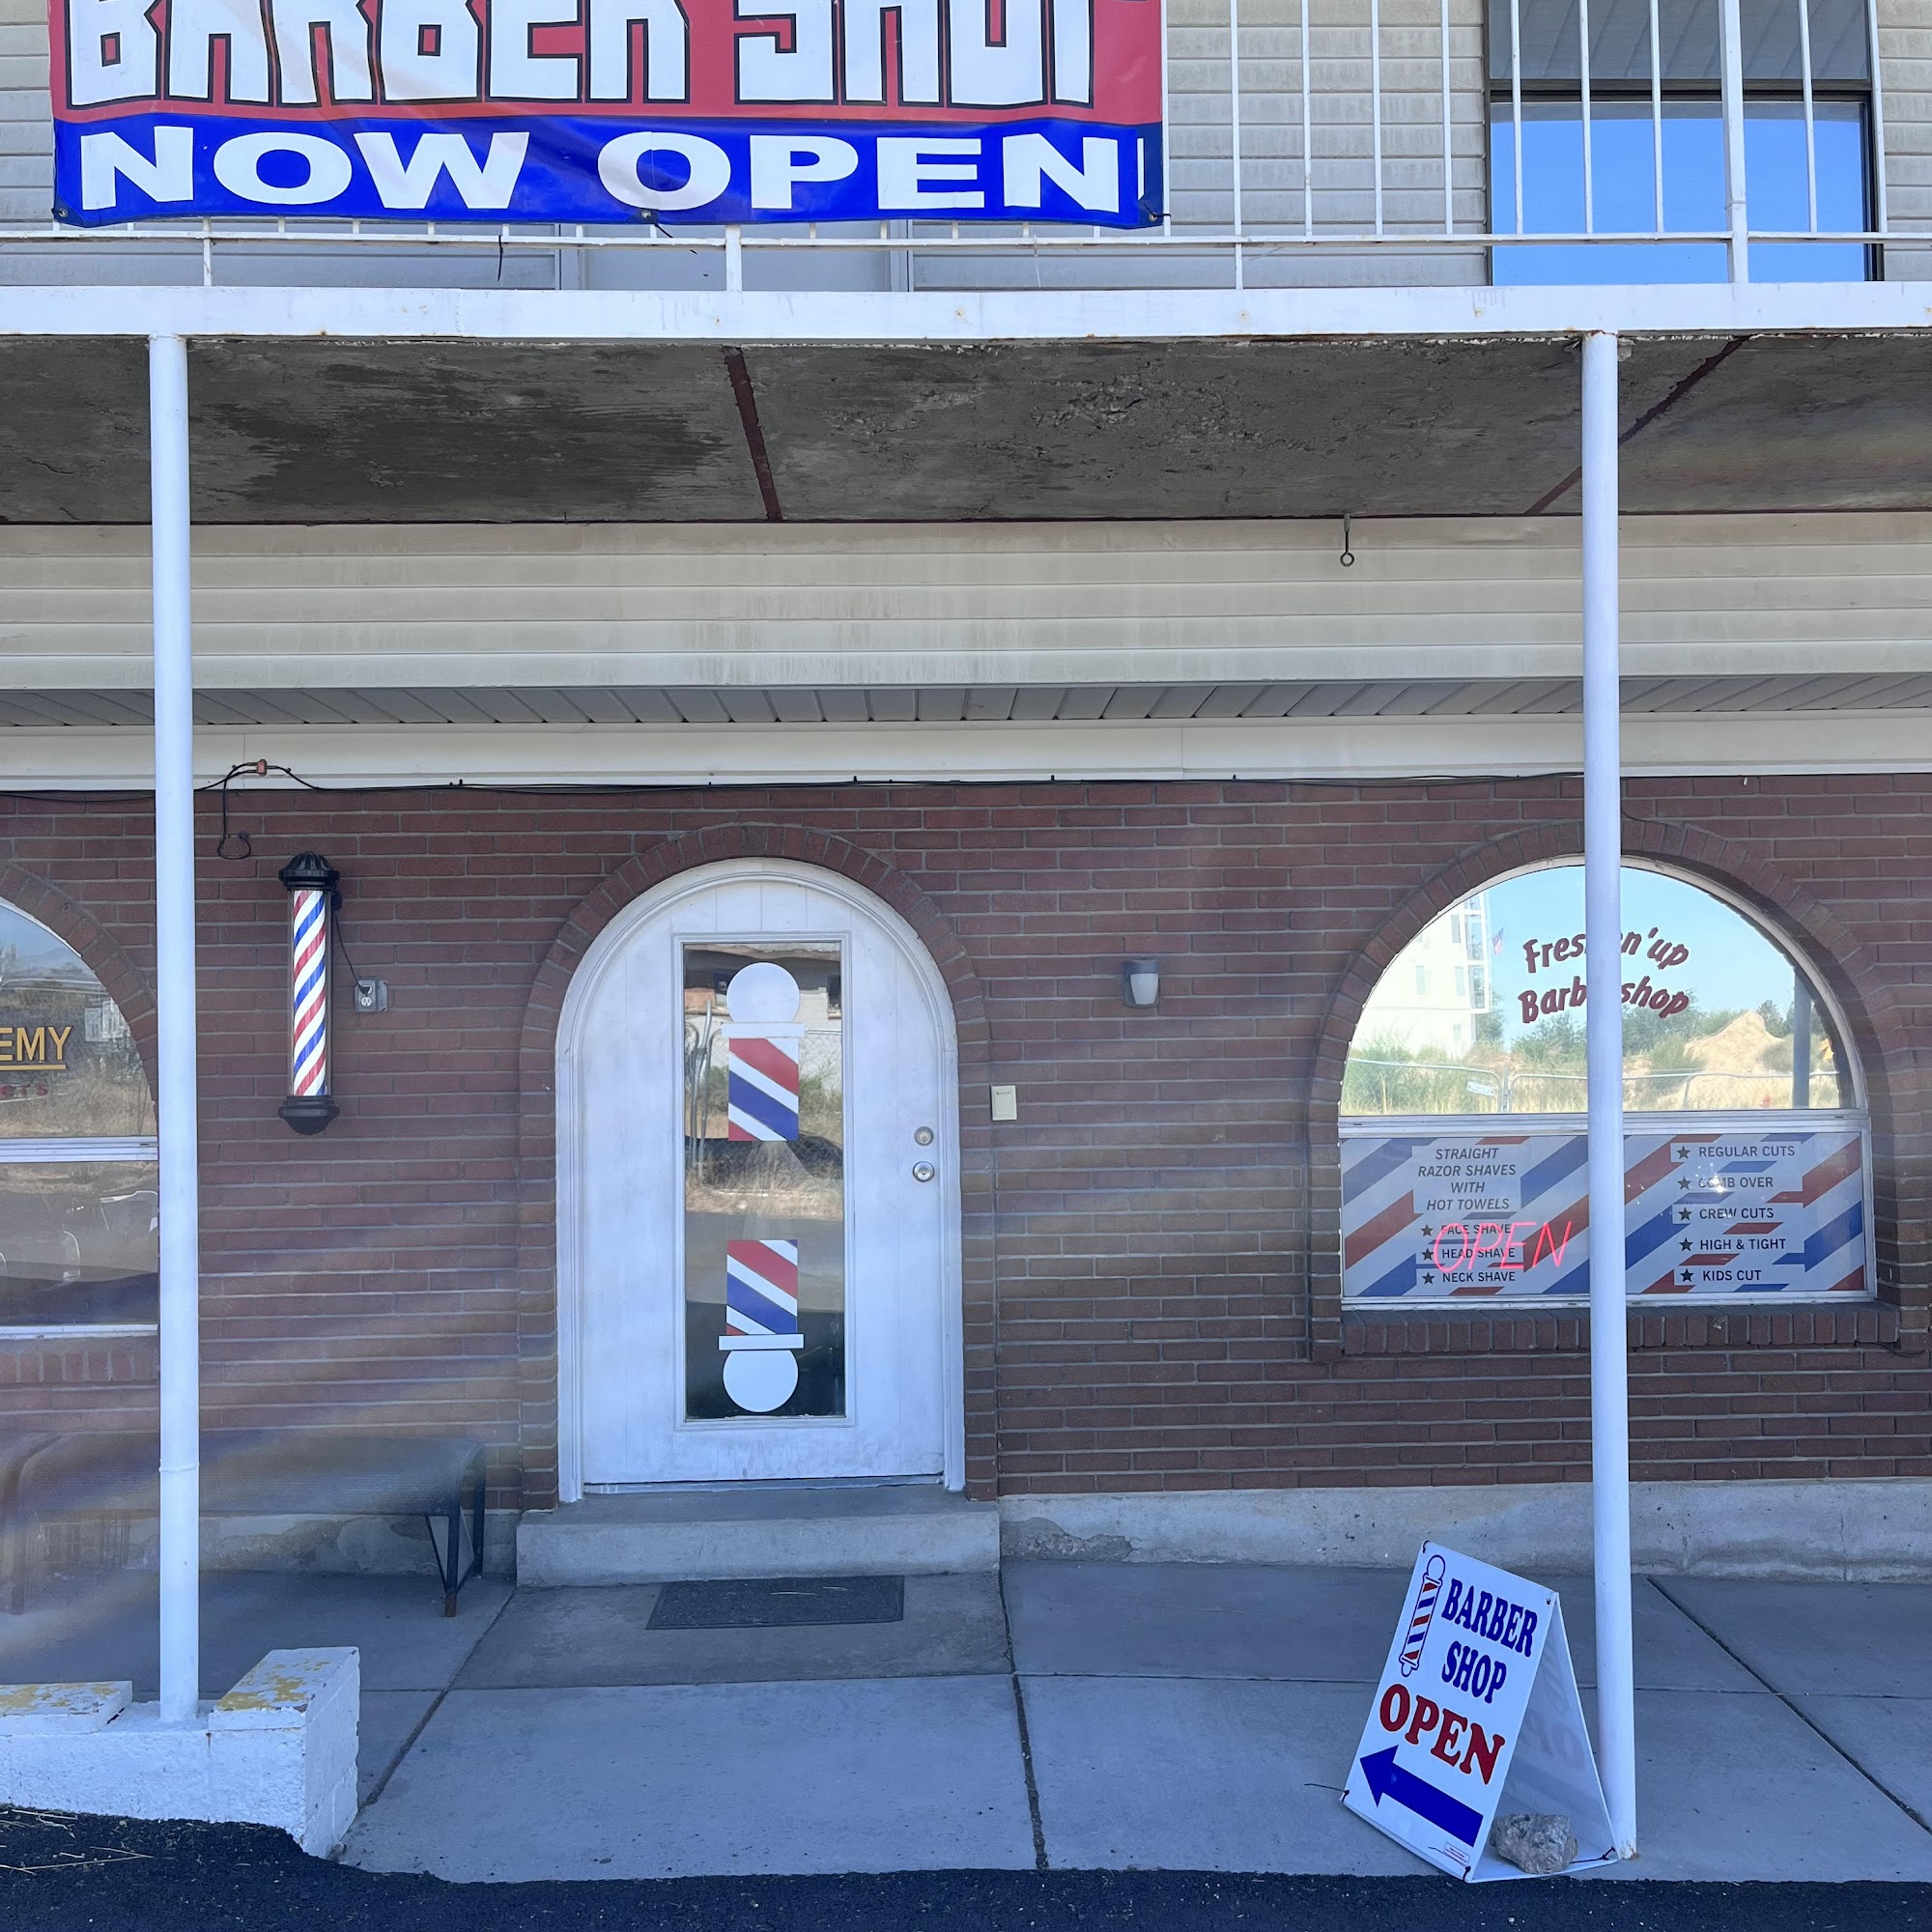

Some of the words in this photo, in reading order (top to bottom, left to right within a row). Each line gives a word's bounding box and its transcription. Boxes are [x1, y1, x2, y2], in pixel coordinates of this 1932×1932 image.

[81, 127, 529, 211] NOW
[598, 131, 1120, 213] OPEN
[1522, 926, 1690, 974] Fresn'up
[1518, 976, 1690, 1023] Barbshop
[1435, 1148, 1499, 1160] STRAIGHT
[1698, 1146, 1758, 1157] REGULAR
[1762, 1146, 1796, 1156] CUTS
[1418, 1165, 1461, 1177] RAZOR
[1465, 1164, 1517, 1176] SHAVES
[1450, 1181, 1486, 1193] WITH
[1740, 1177, 1774, 1188] OVER
[1427, 1199, 1454, 1210] HOT
[1458, 1198, 1510, 1209] TOWELS
[1699, 1208, 1737, 1219] CREW
[1741, 1208, 1775, 1218] CUTS
[1441, 1224, 1470, 1235] FACE
[1473, 1223, 1511, 1234] SHAVE
[1433, 1220, 1573, 1273] OPEN
[1700, 1239, 1732, 1250] HIGH
[1736, 1239, 1745, 1250] &
[1748, 1238, 1786, 1249] TIGHT
[1442, 1248, 1473, 1259] HEAD
[1478, 1247, 1515, 1258] SHAVE
[1442, 1272, 1474, 1283] NECK
[1478, 1271, 1516, 1282] SHAVE
[1703, 1270, 1733, 1281] KIDS
[1737, 1270, 1762, 1281] CUT
[1440, 1577, 1538, 1657] BARBER
[1441, 1640, 1507, 1704] SHOP
[1378, 1683, 1506, 1785] OPEN
